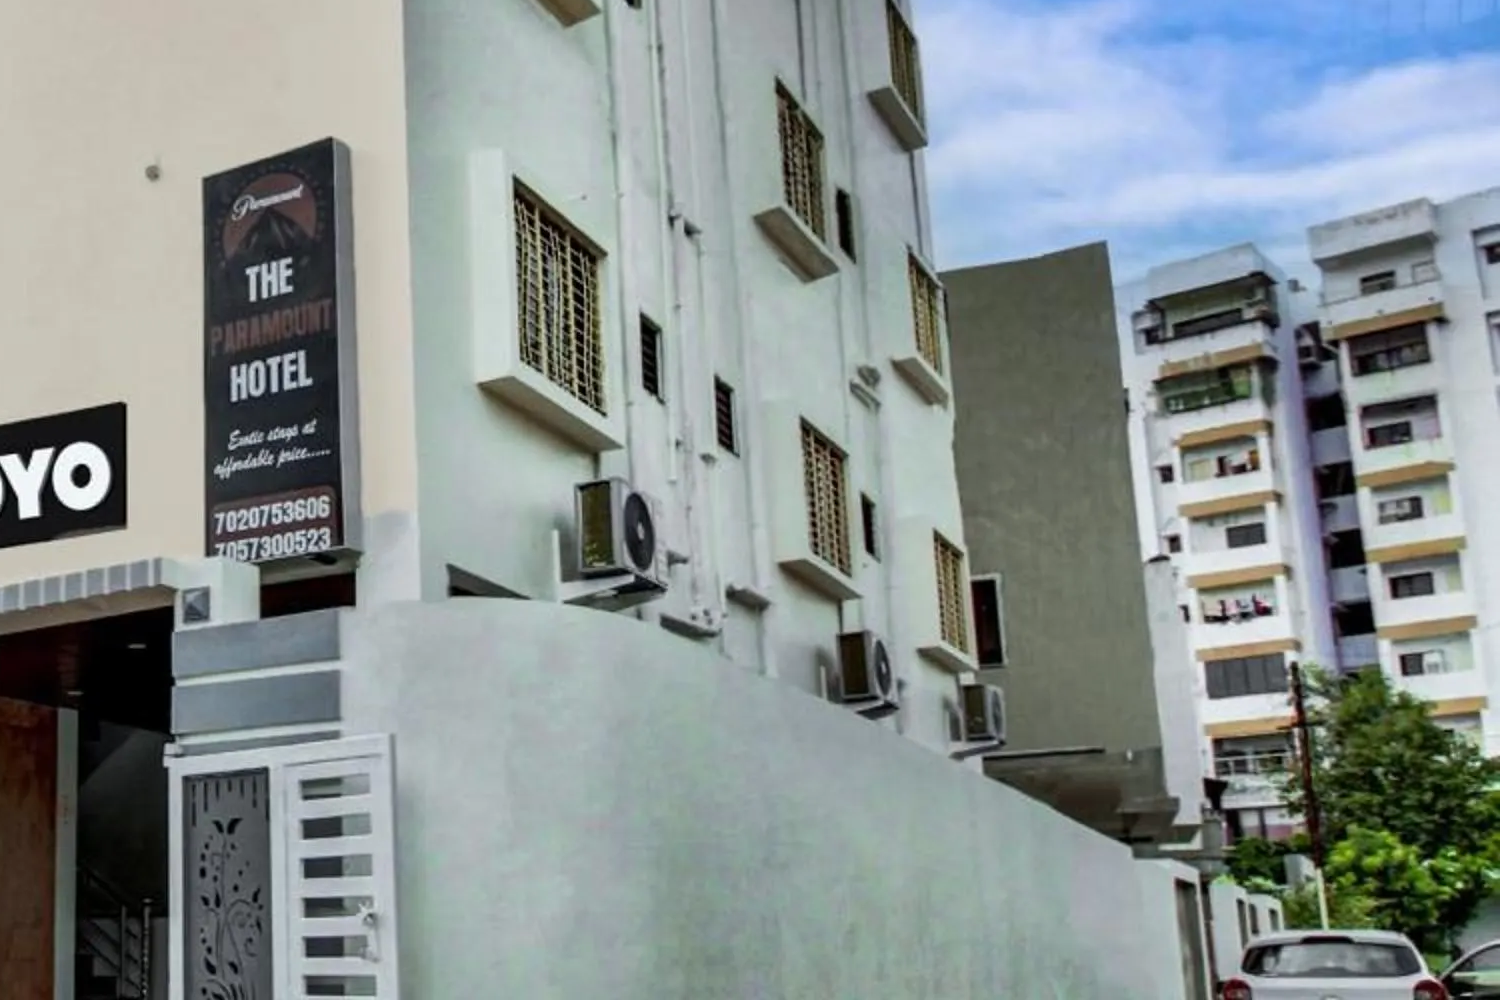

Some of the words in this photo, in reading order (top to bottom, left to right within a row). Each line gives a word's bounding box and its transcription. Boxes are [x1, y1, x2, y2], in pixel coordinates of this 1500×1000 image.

[245, 256, 293, 302] THE
[210, 298, 332, 358] PARAMOUNT
[229, 350, 313, 402] HOTEL
[228, 428, 265, 450] Exotic
[301, 417, 317, 435] at
[213, 448, 275, 480] affordable
[214, 495, 331, 535] 7020753606
[214, 527, 331, 562] 7057300523
